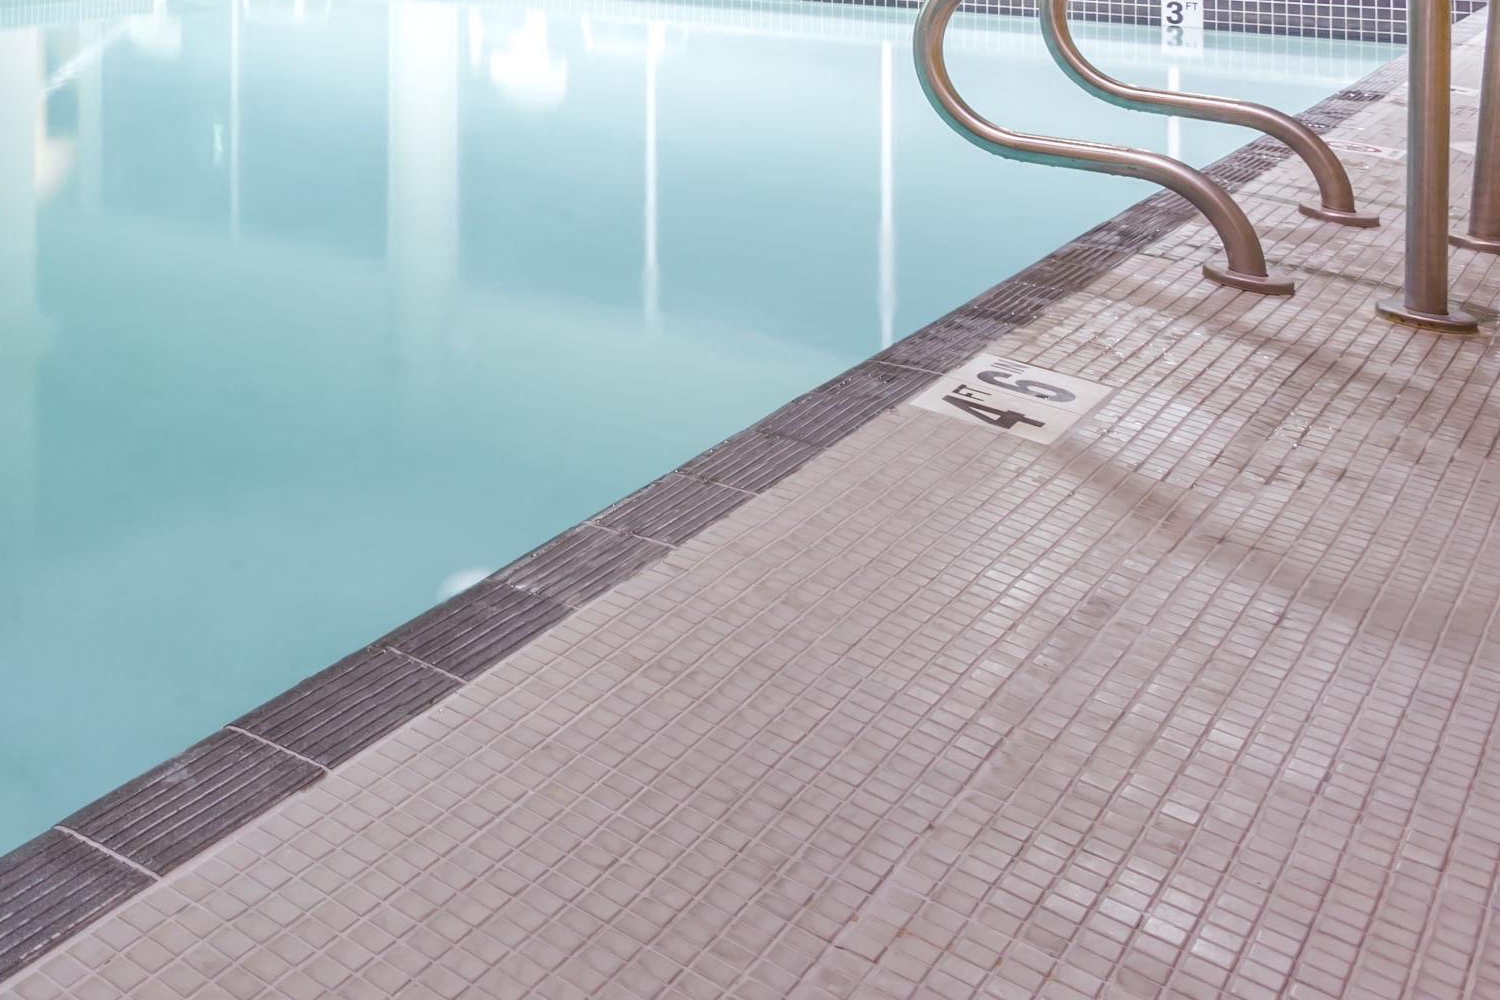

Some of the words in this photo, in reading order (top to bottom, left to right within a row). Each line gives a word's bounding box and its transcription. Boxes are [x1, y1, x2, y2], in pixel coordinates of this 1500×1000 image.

[1166, 1, 1183, 25] 3
[1186, 2, 1199, 11] FT
[990, 358, 1030, 375] IN
[952, 384, 992, 402] FT
[977, 370, 1077, 403] 6
[941, 395, 1046, 430] 4
